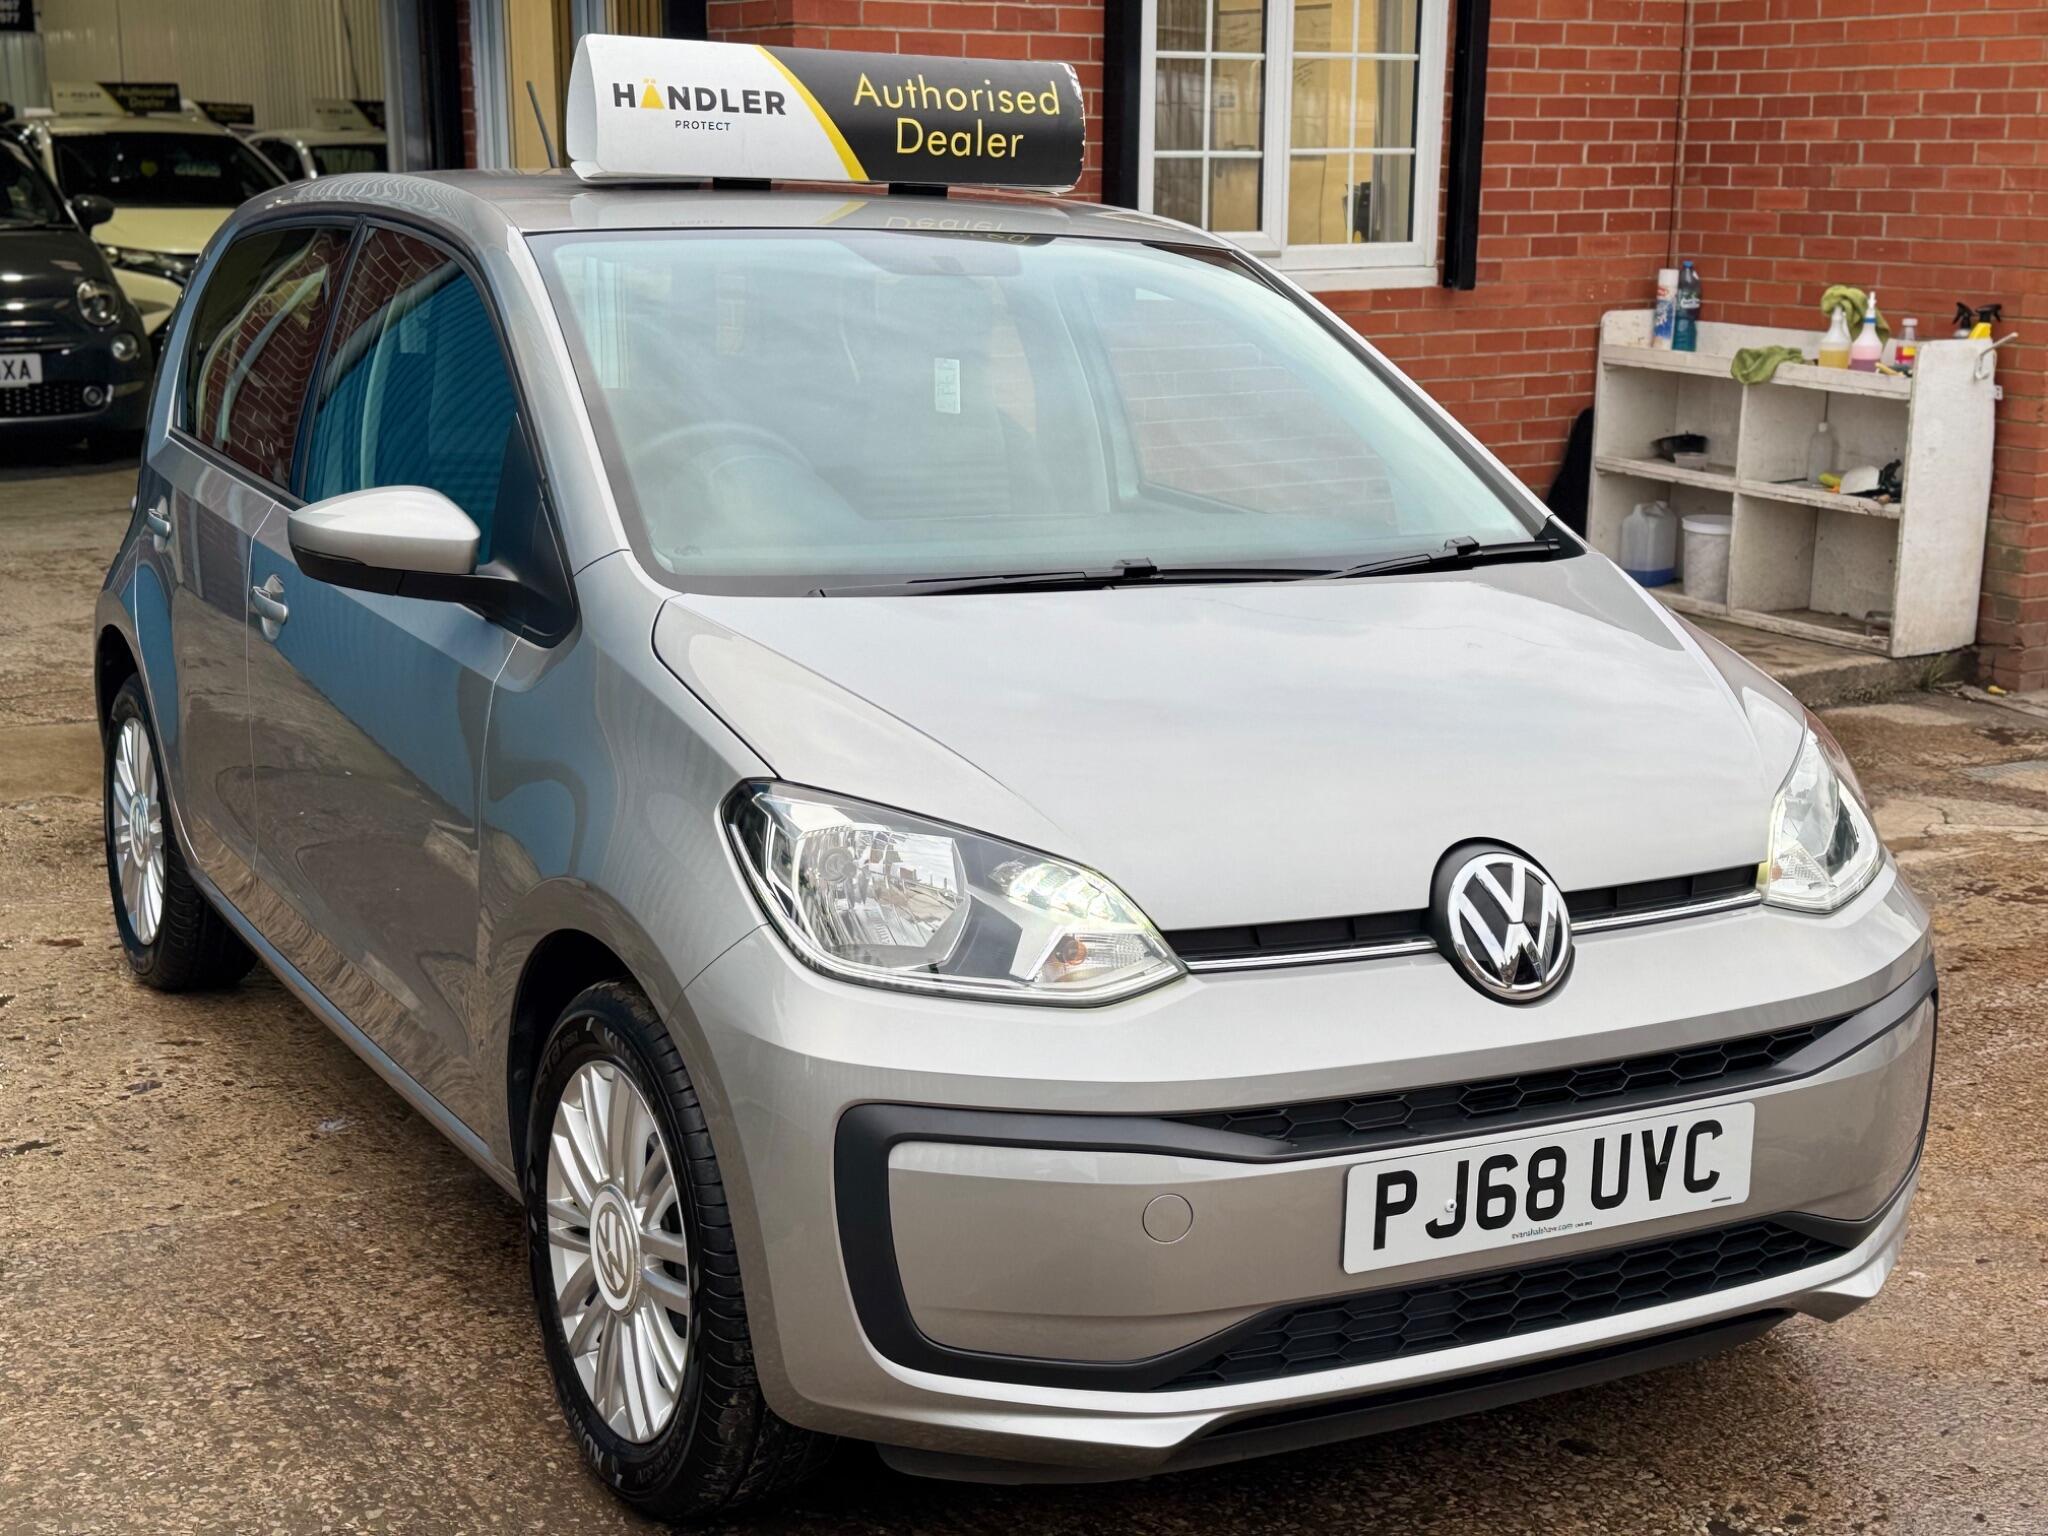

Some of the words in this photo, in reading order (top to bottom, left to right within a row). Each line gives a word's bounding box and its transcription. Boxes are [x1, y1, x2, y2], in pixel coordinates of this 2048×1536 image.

[853, 72, 1060, 115] Authorised
[674, 119, 731, 131] PROTECT
[896, 117, 1024, 158] Dealer
[0, 358, 32, 380] XA
[1372, 1145, 1568, 1250] PJ68
[1590, 1119, 1723, 1210] UVC
